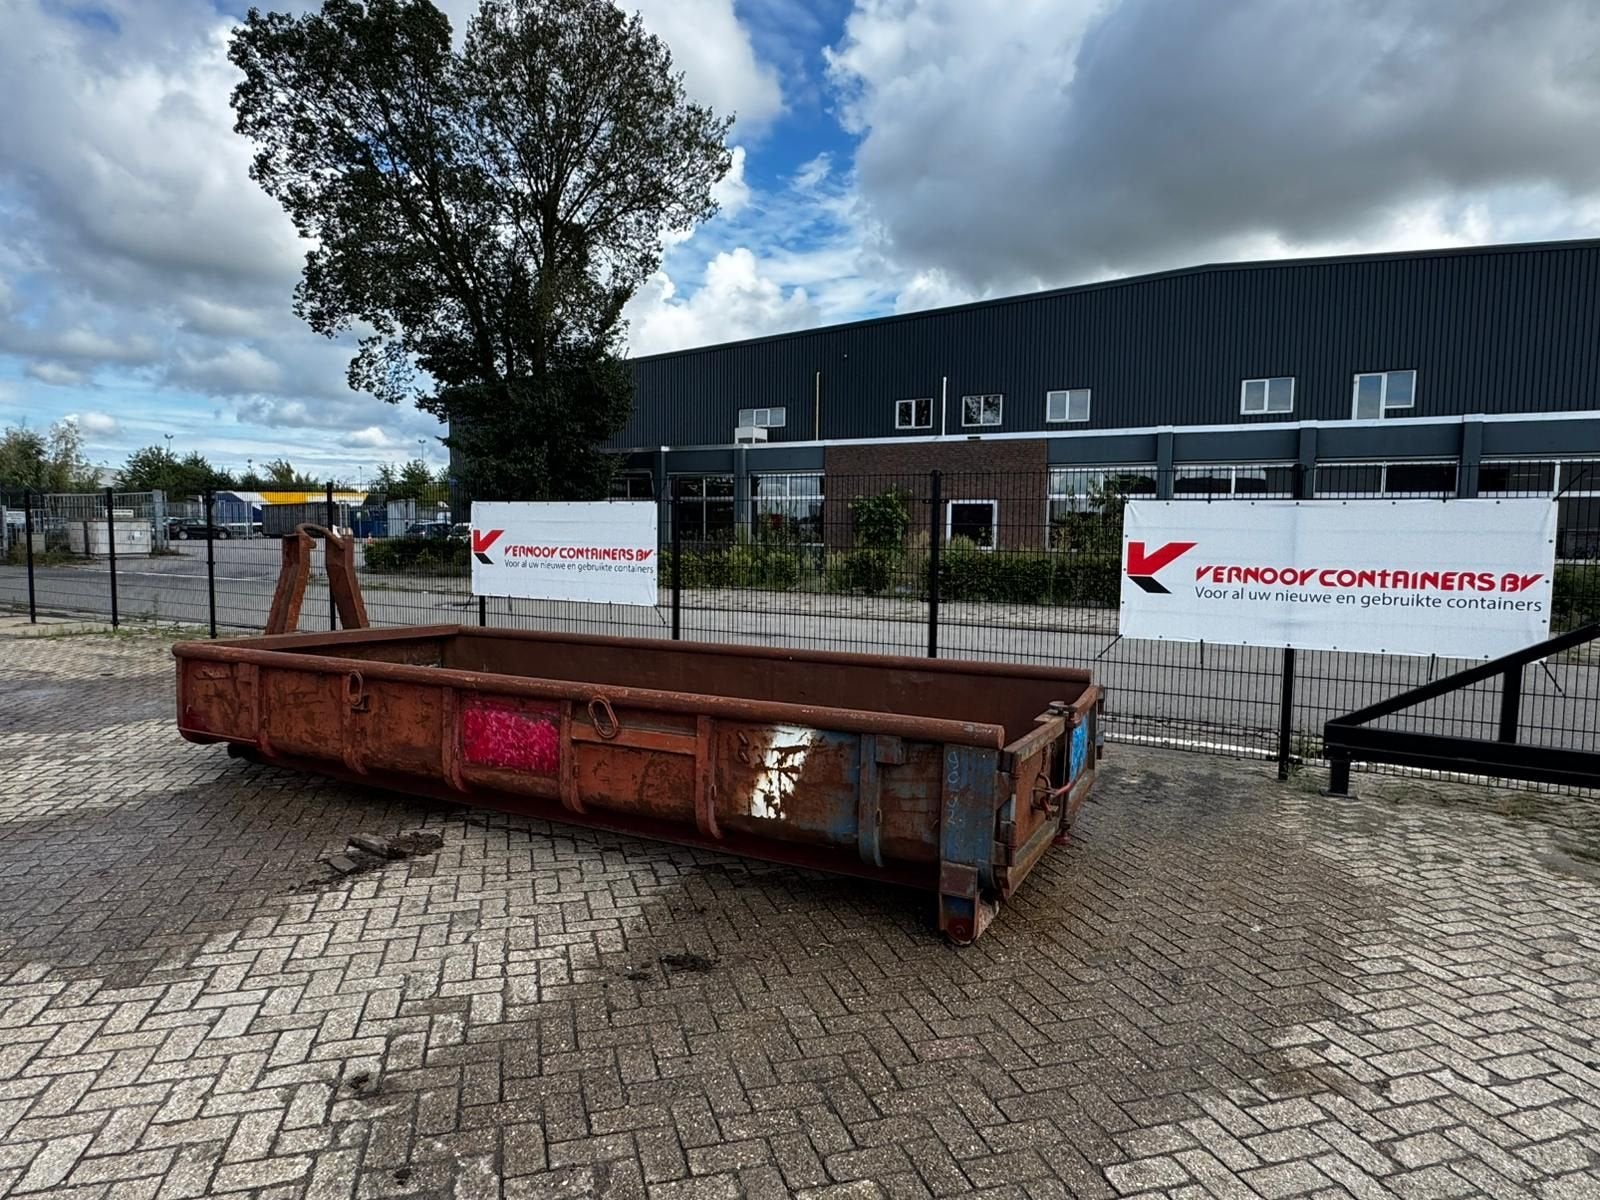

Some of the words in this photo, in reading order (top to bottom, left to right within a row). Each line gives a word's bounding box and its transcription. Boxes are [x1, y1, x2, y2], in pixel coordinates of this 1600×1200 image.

[504, 545, 559, 558] VERNOOY
[559, 547, 634, 561] CONTAINERS
[635, 549, 654, 561] BV
[504, 559, 519, 568] Voor
[521, 559, 528, 568] al
[529, 561, 539, 569] uw
[540, 560, 566, 570] nieuwe
[578, 562, 613, 573] gebruikte
[614, 564, 654, 574] containers
[1196, 566, 1318, 586] VERNOOY
[1318, 569, 1496, 592] CONTAINERS
[1500, 573, 1545, 592] BV
[1195, 586, 1228, 600] Voor
[1231, 587, 1244, 600] al
[1249, 590, 1271, 601] uw
[1275, 589, 1332, 604] nieuwe
[1336, 593, 1355, 604] en
[1360, 593, 1442, 608] gebruikte
[1446, 597, 1542, 612] containers
